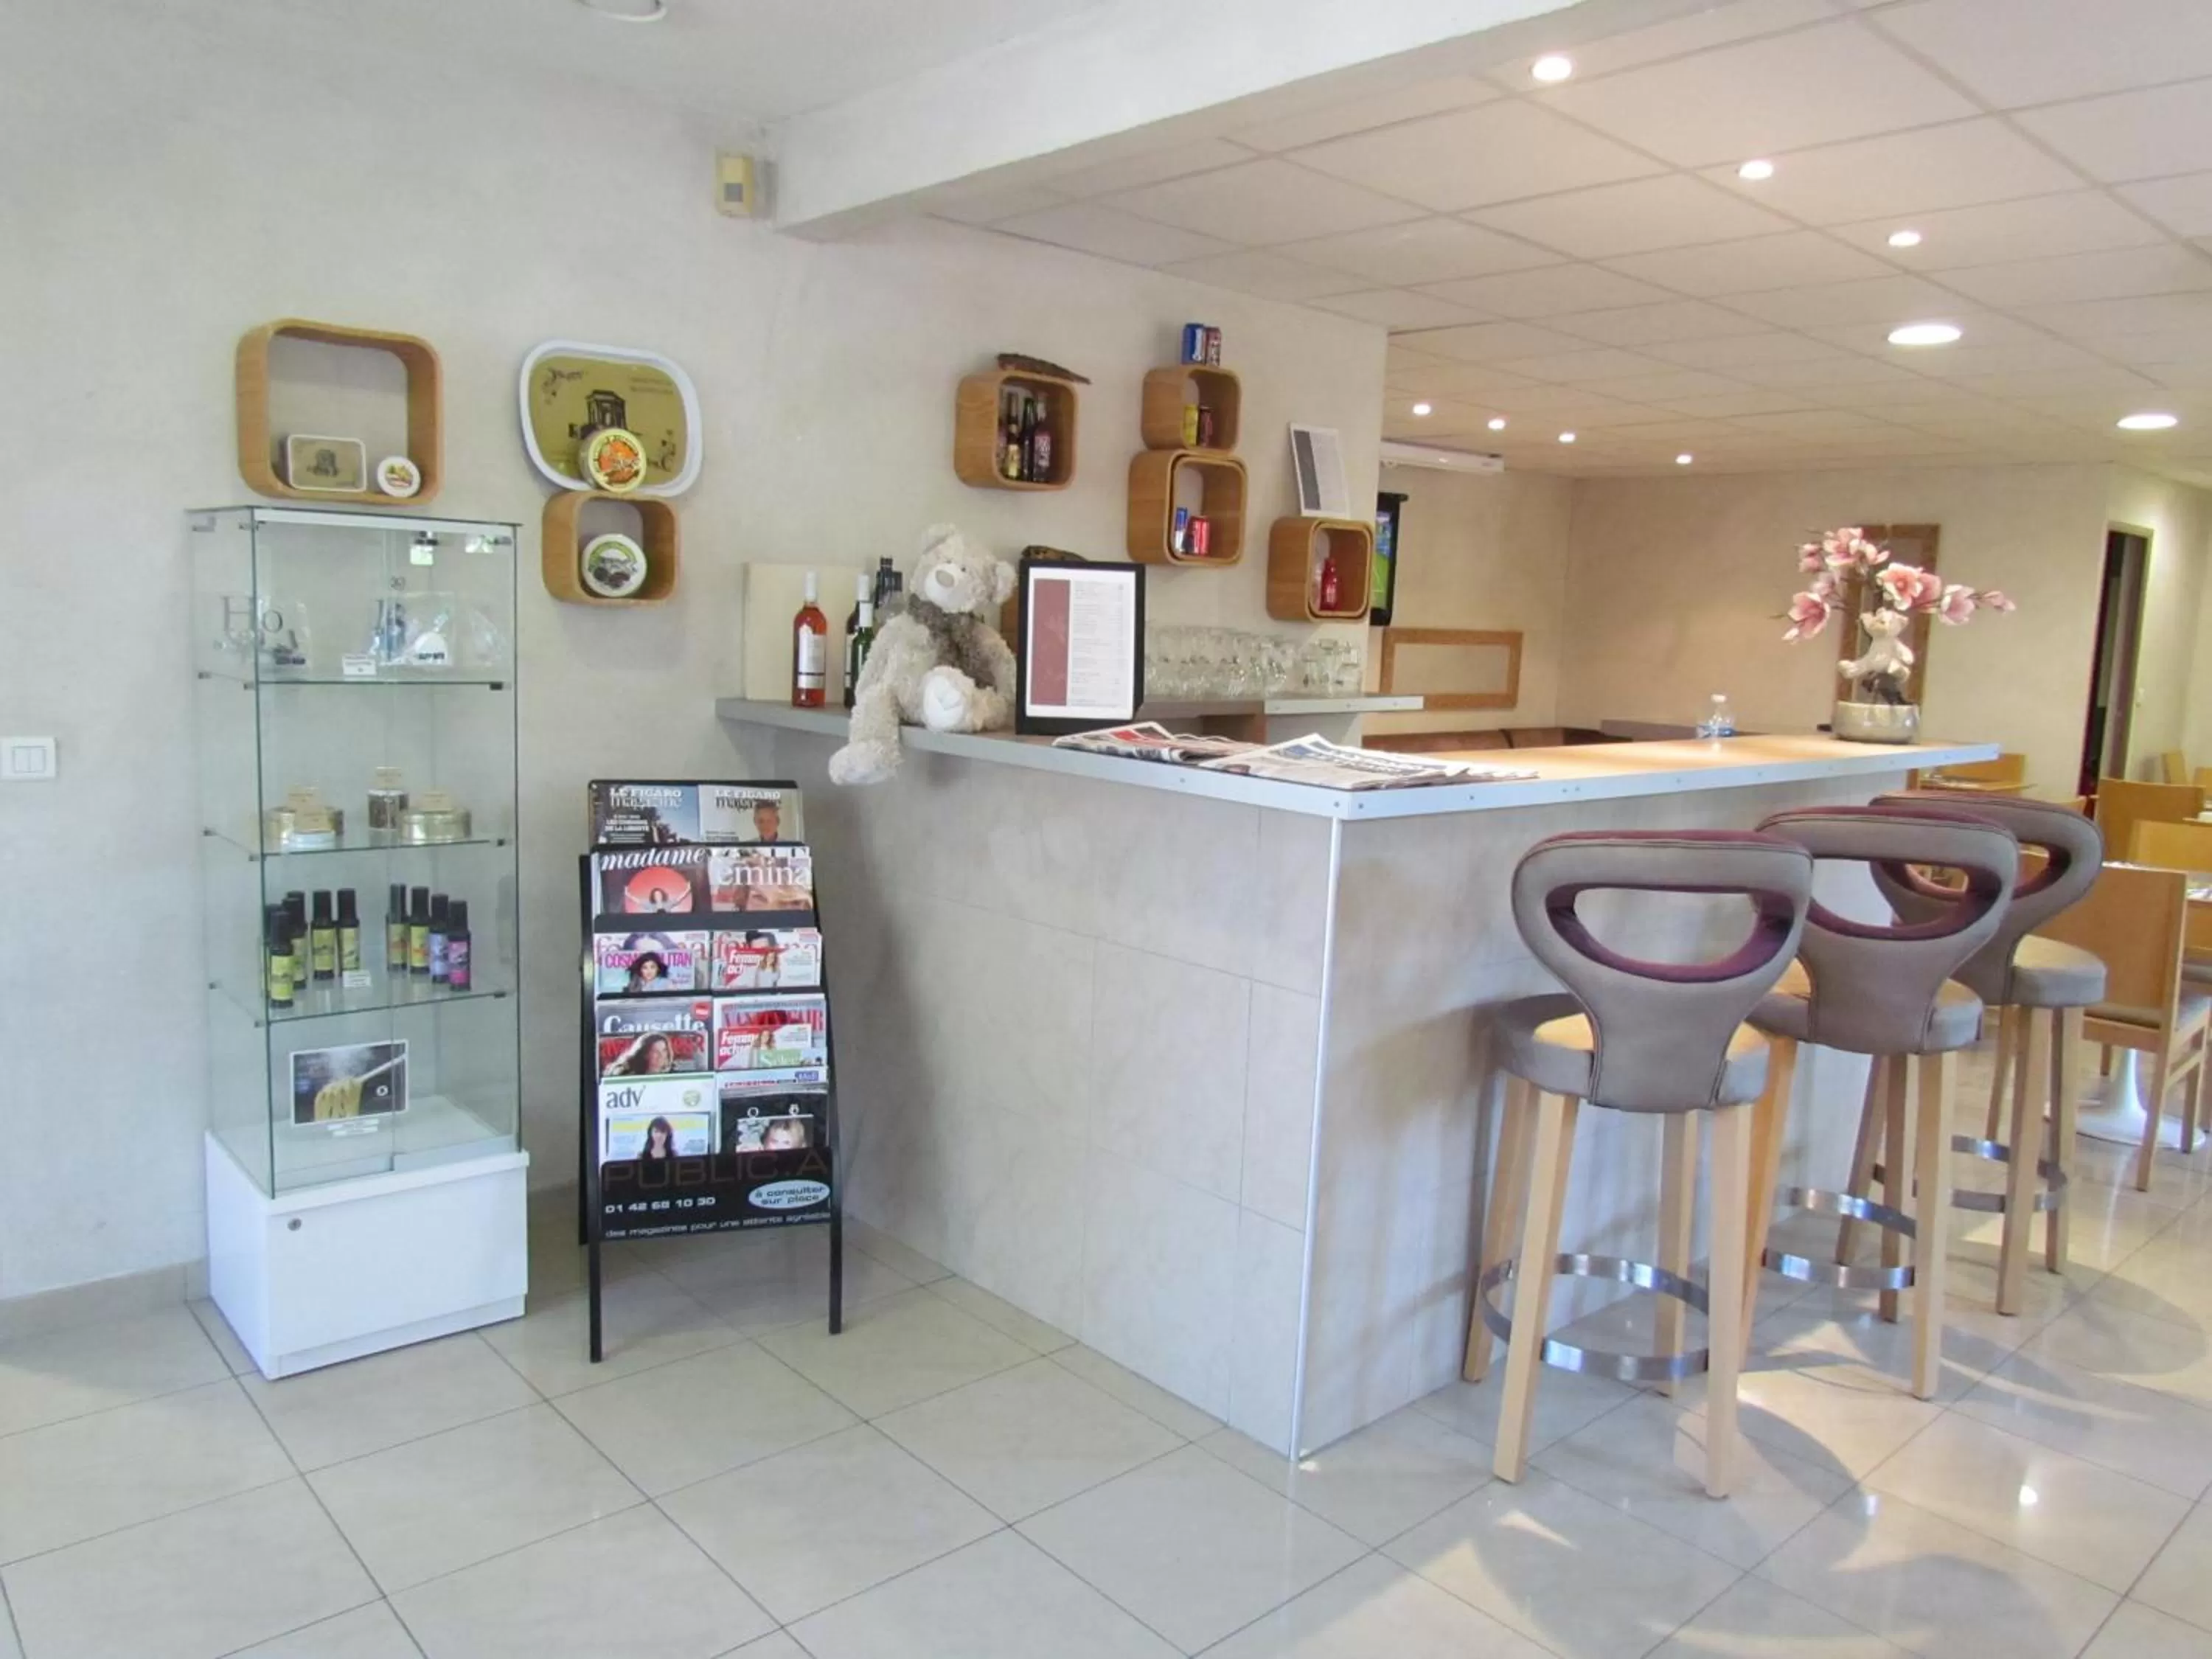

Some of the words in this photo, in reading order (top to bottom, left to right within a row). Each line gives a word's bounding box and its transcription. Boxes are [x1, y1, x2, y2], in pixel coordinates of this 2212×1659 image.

[630, 787, 682, 798] FIGARO
[734, 790, 781, 800] FIGARO
[601, 846, 706, 871] madame
[766, 1186, 826, 1196] consulter
[760, 1197, 782, 1206] sur
[787, 1194, 820, 1204] place
[605, 1203, 623, 1214] 01
[627, 1202, 647, 1212] 42
[675, 1198, 694, 1208] 10
[690, 1221, 717, 1232] pour
